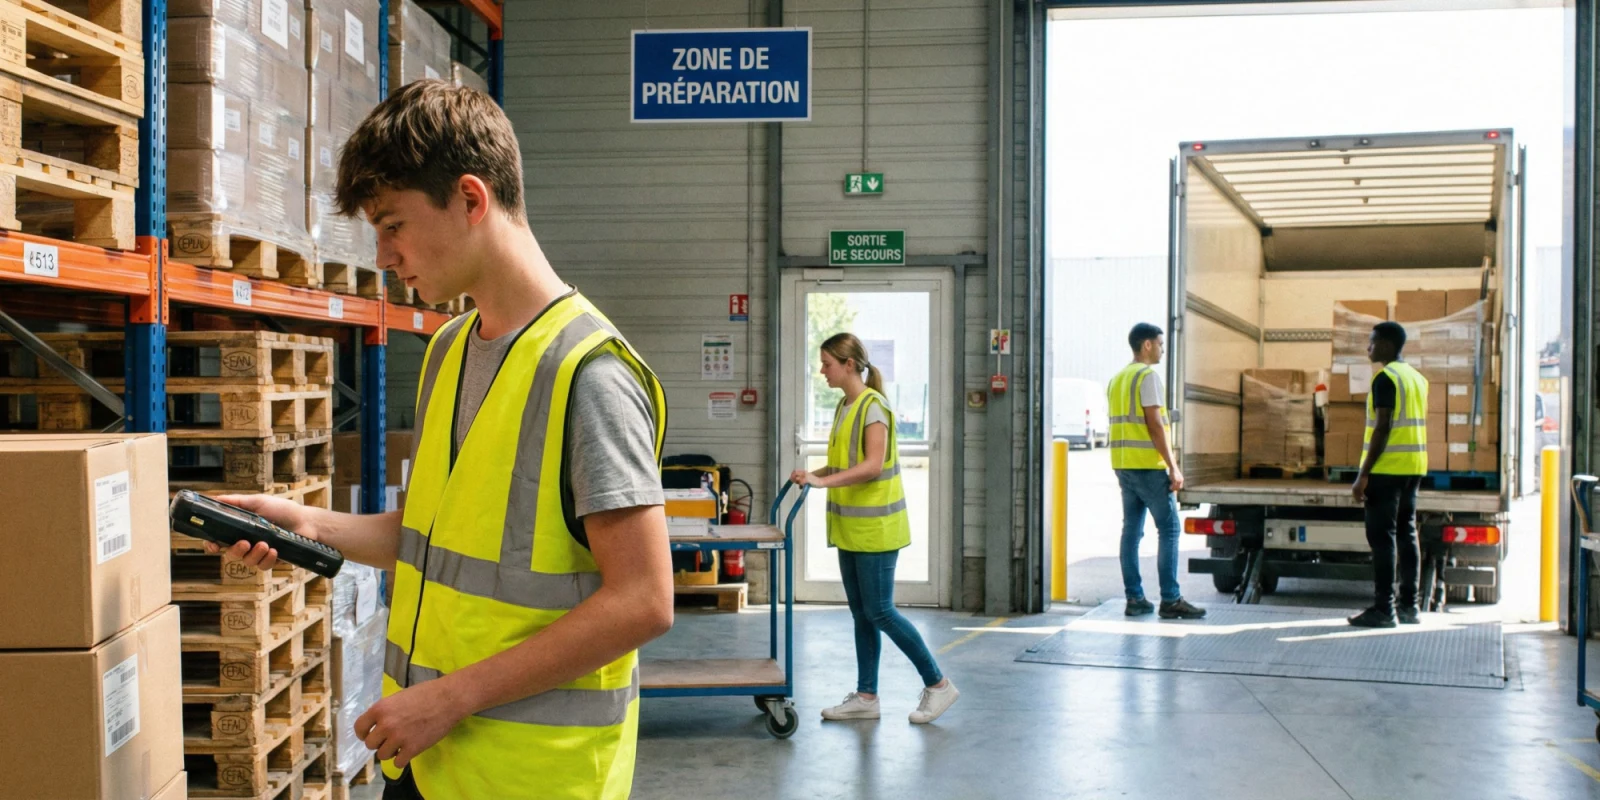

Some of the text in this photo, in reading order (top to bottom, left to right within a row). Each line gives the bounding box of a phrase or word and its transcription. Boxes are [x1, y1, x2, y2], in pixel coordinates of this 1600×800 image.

[672, 47, 769, 70] ZONE DE
[642, 76, 799, 104] PRÉPARATION
[847, 234, 887, 246] SORTIE
[833, 248, 901, 260] DE SECOURS
